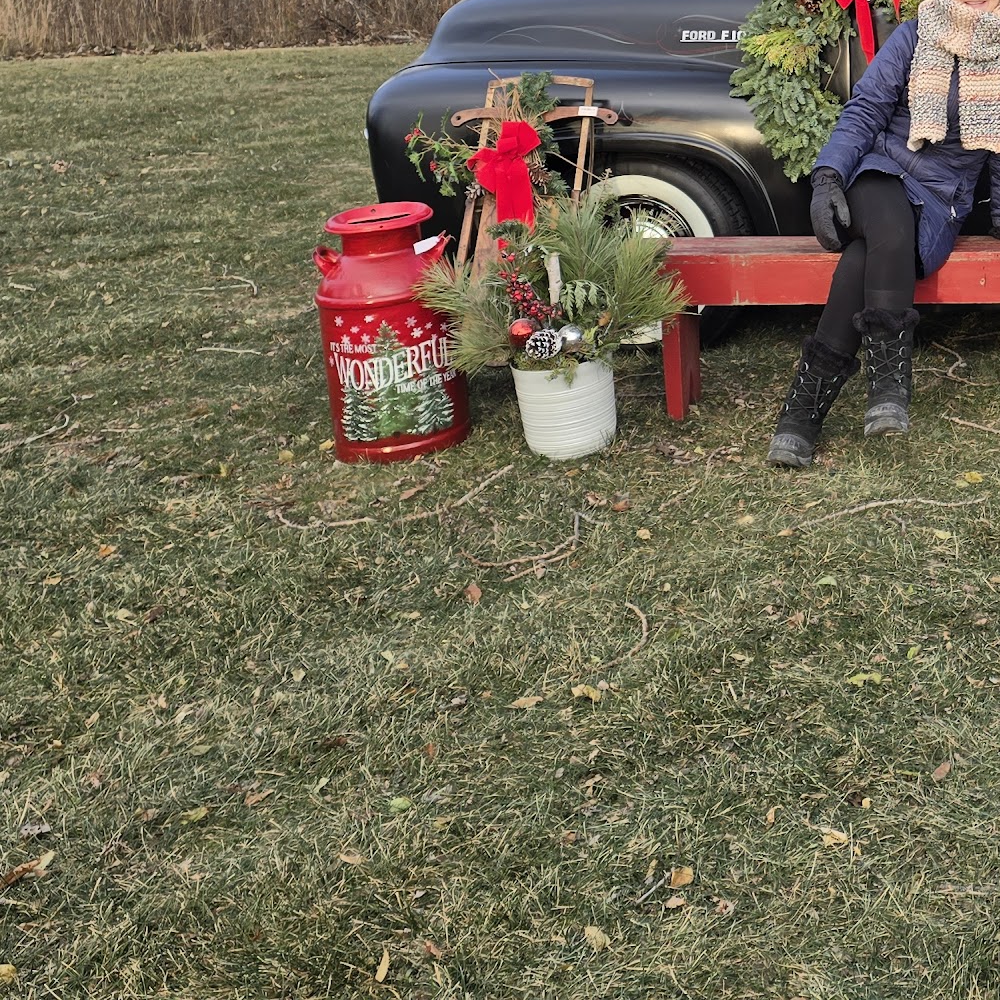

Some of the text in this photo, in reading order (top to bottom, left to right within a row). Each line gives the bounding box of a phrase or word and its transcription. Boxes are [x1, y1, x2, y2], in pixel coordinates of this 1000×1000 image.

[681, 30, 716, 41] FORD
[340, 343, 354, 354] THE
[354, 344, 378, 354] MOST
[334, 337, 453, 390] WONDERFUL
[395, 381, 415, 393] TIME
[416, 376, 430, 391] OF
[429, 373, 443, 387] THE
